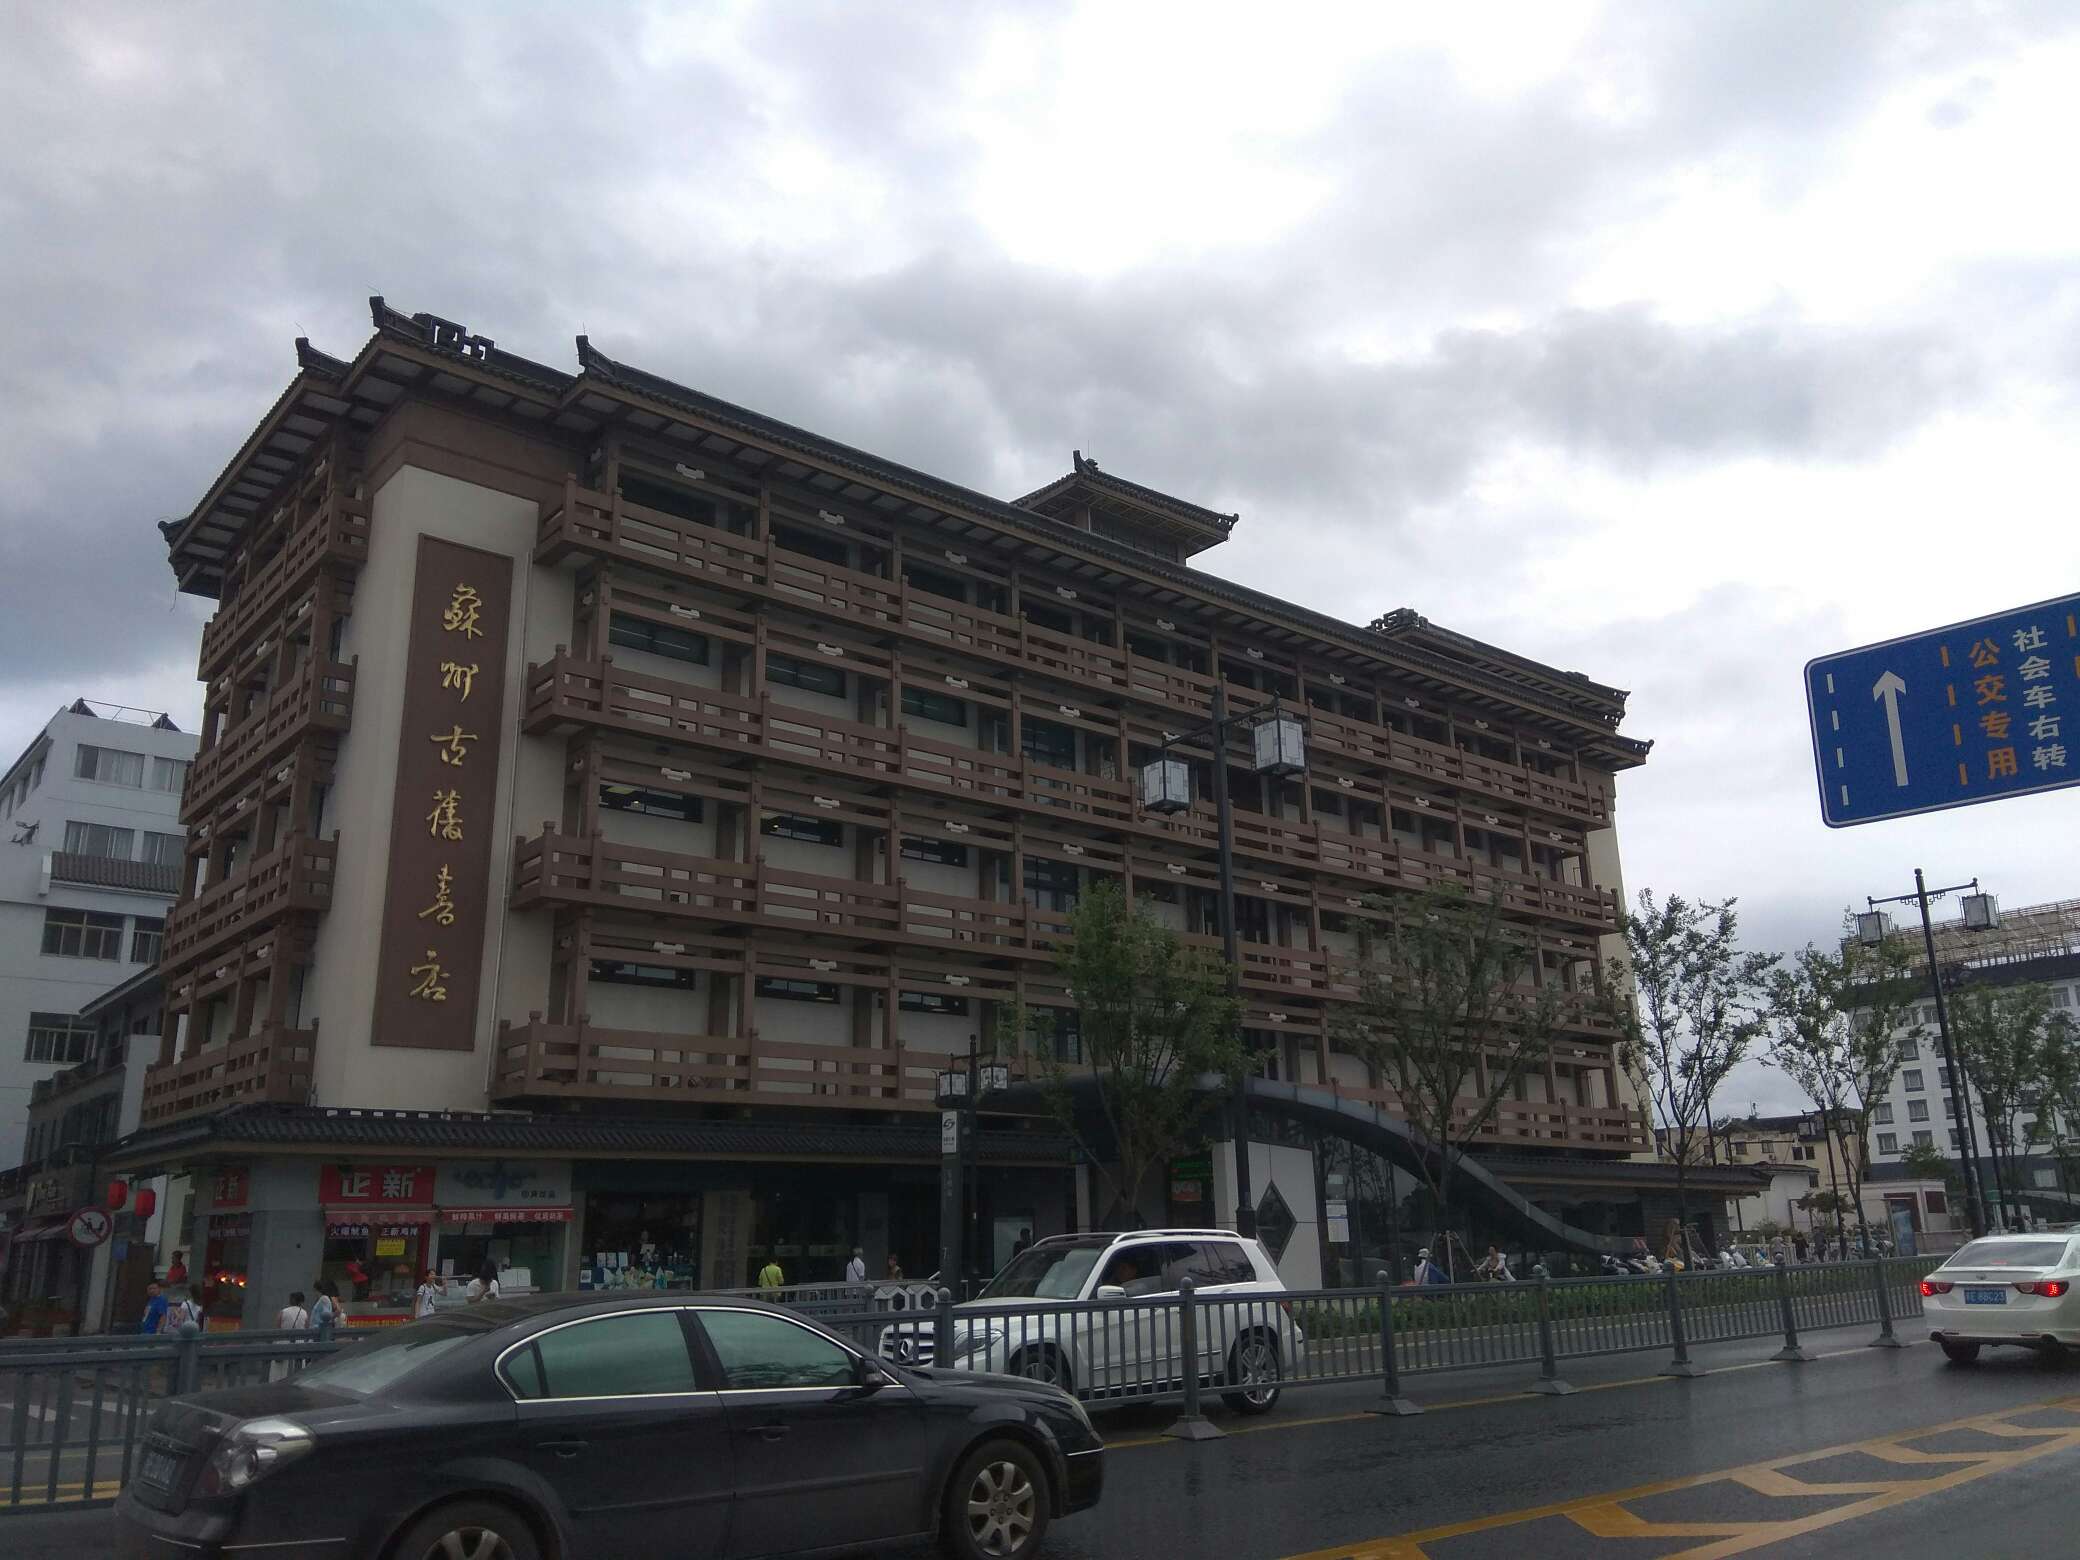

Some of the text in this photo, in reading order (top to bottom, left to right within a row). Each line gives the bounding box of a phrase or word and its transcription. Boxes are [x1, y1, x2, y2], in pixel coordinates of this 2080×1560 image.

[1968, 637, 2019, 780] 公交专用
[2011, 625, 2068, 771] 社会车右转
[341, 1169, 416, 1198] 正新
